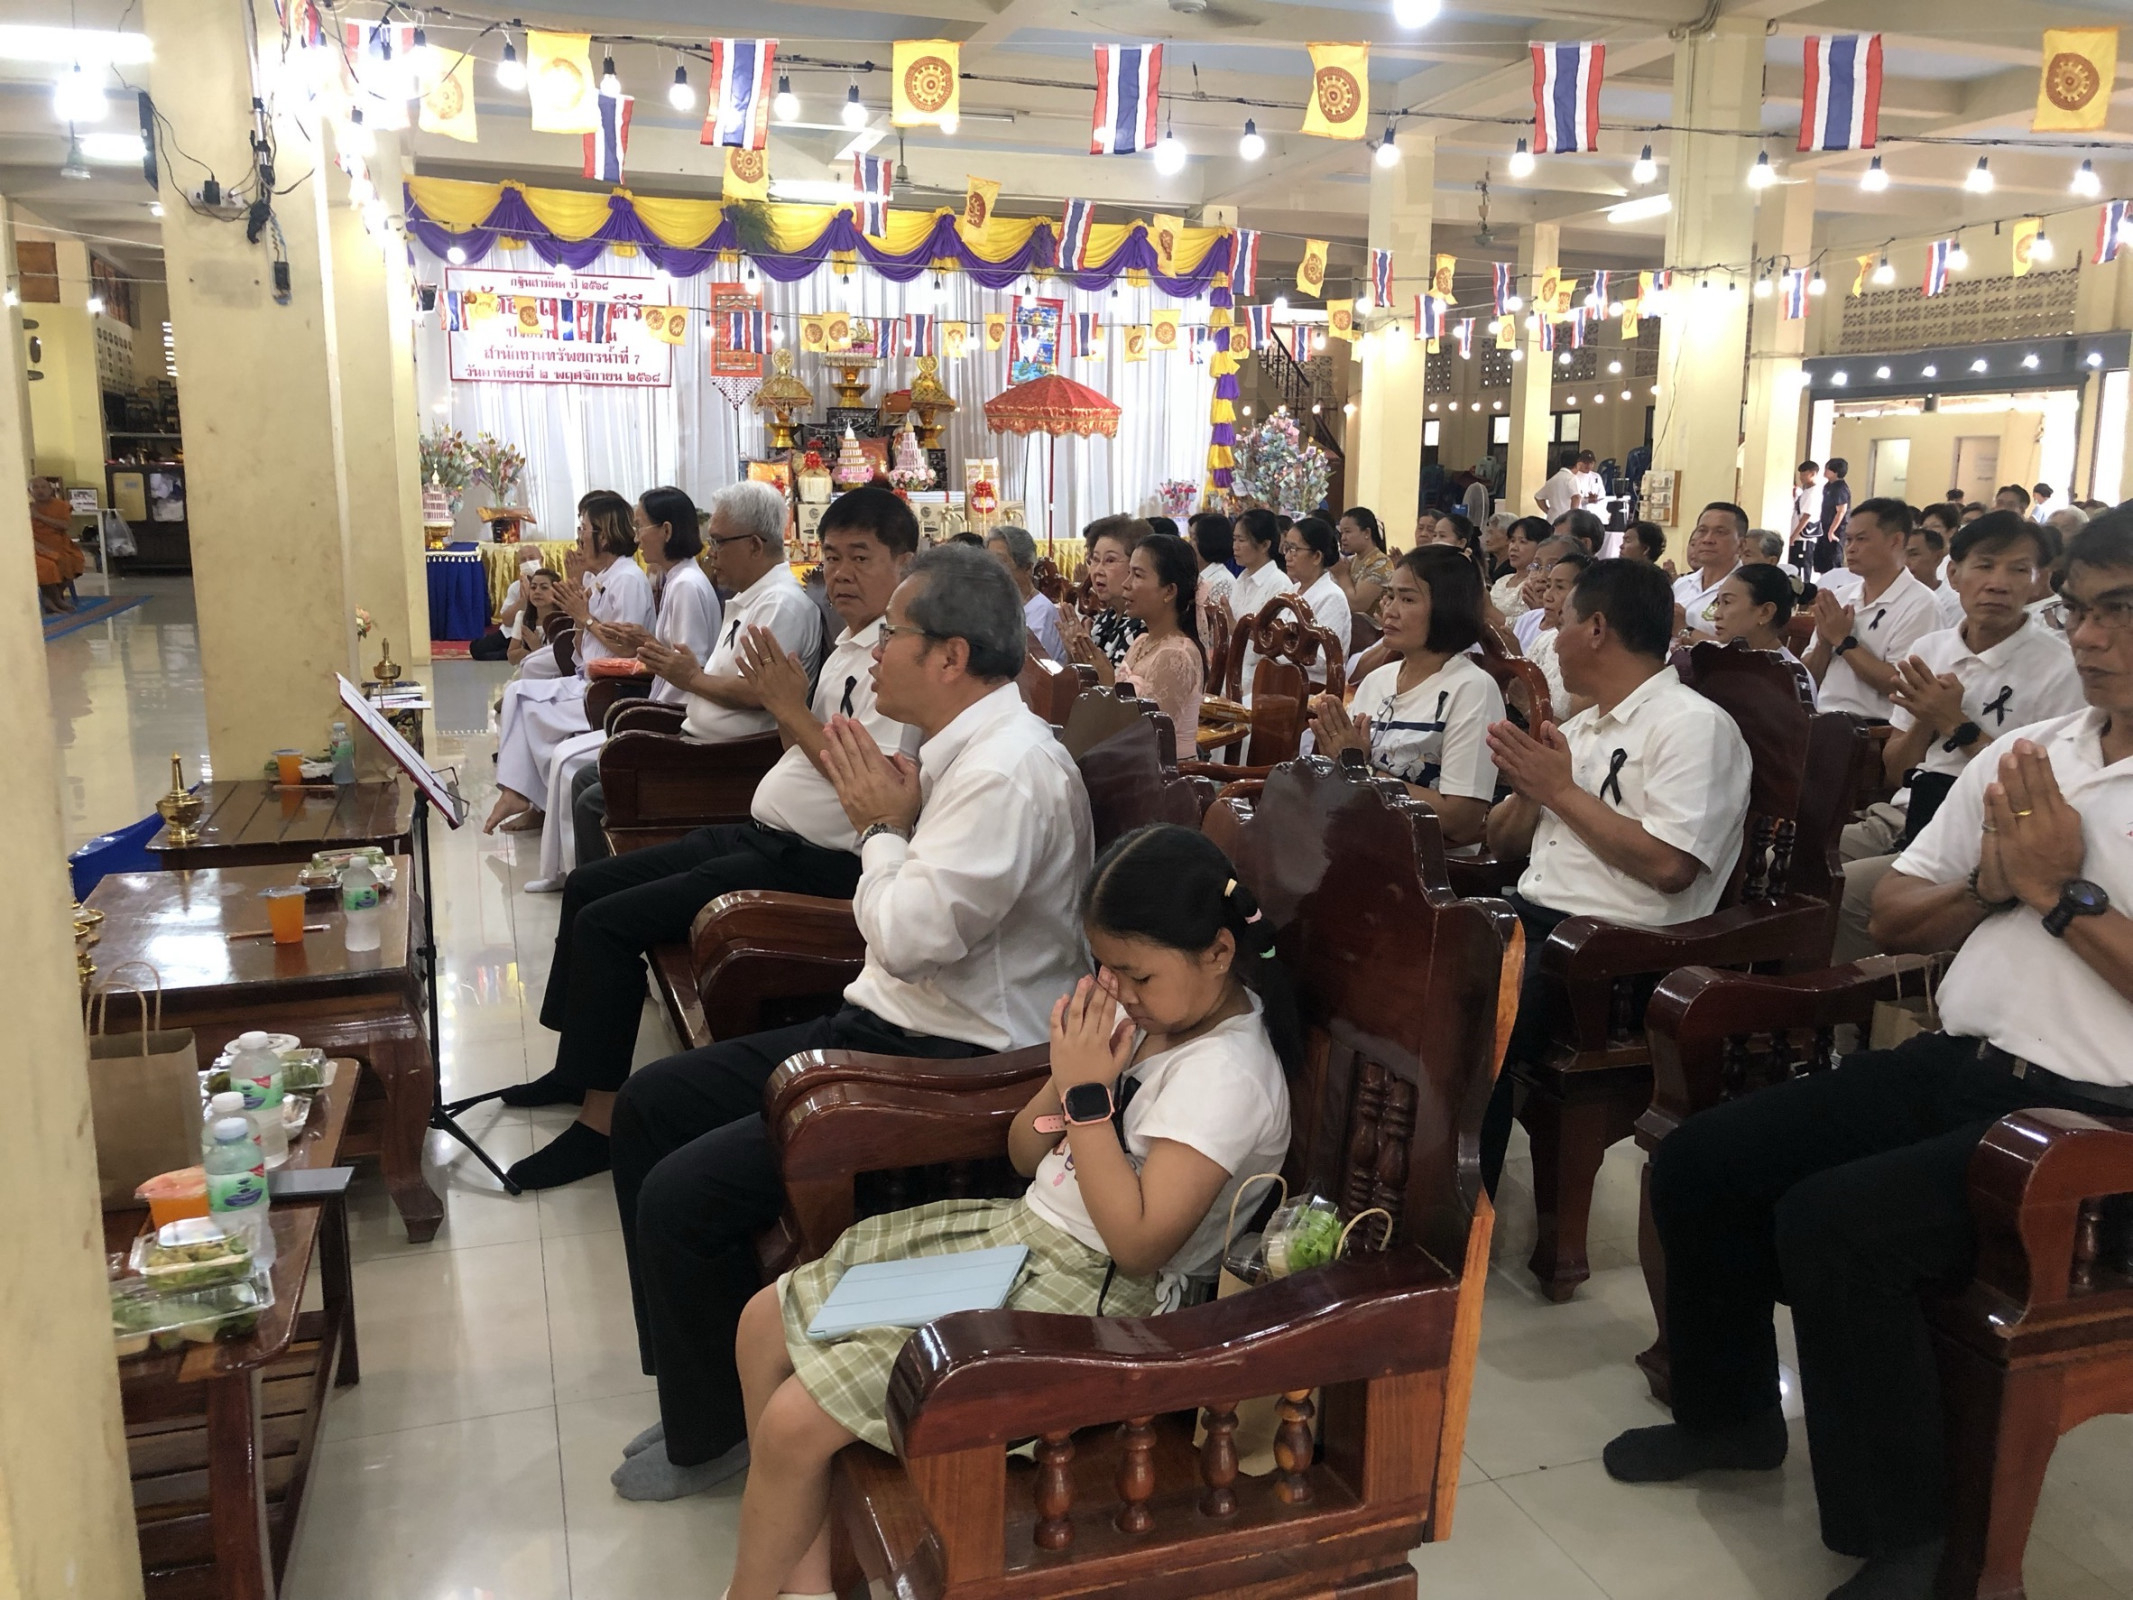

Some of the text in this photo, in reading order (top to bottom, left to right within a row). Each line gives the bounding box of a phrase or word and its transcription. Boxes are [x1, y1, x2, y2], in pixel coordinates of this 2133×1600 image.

[581, 280, 609, 291] ๒๕๖๘
[634, 354, 641, 365] 7
[539, 369, 549, 380] ๒
[554, 369, 623, 383] พฤศจิกายน
[627, 371, 661, 383] ๒๕๖๘
